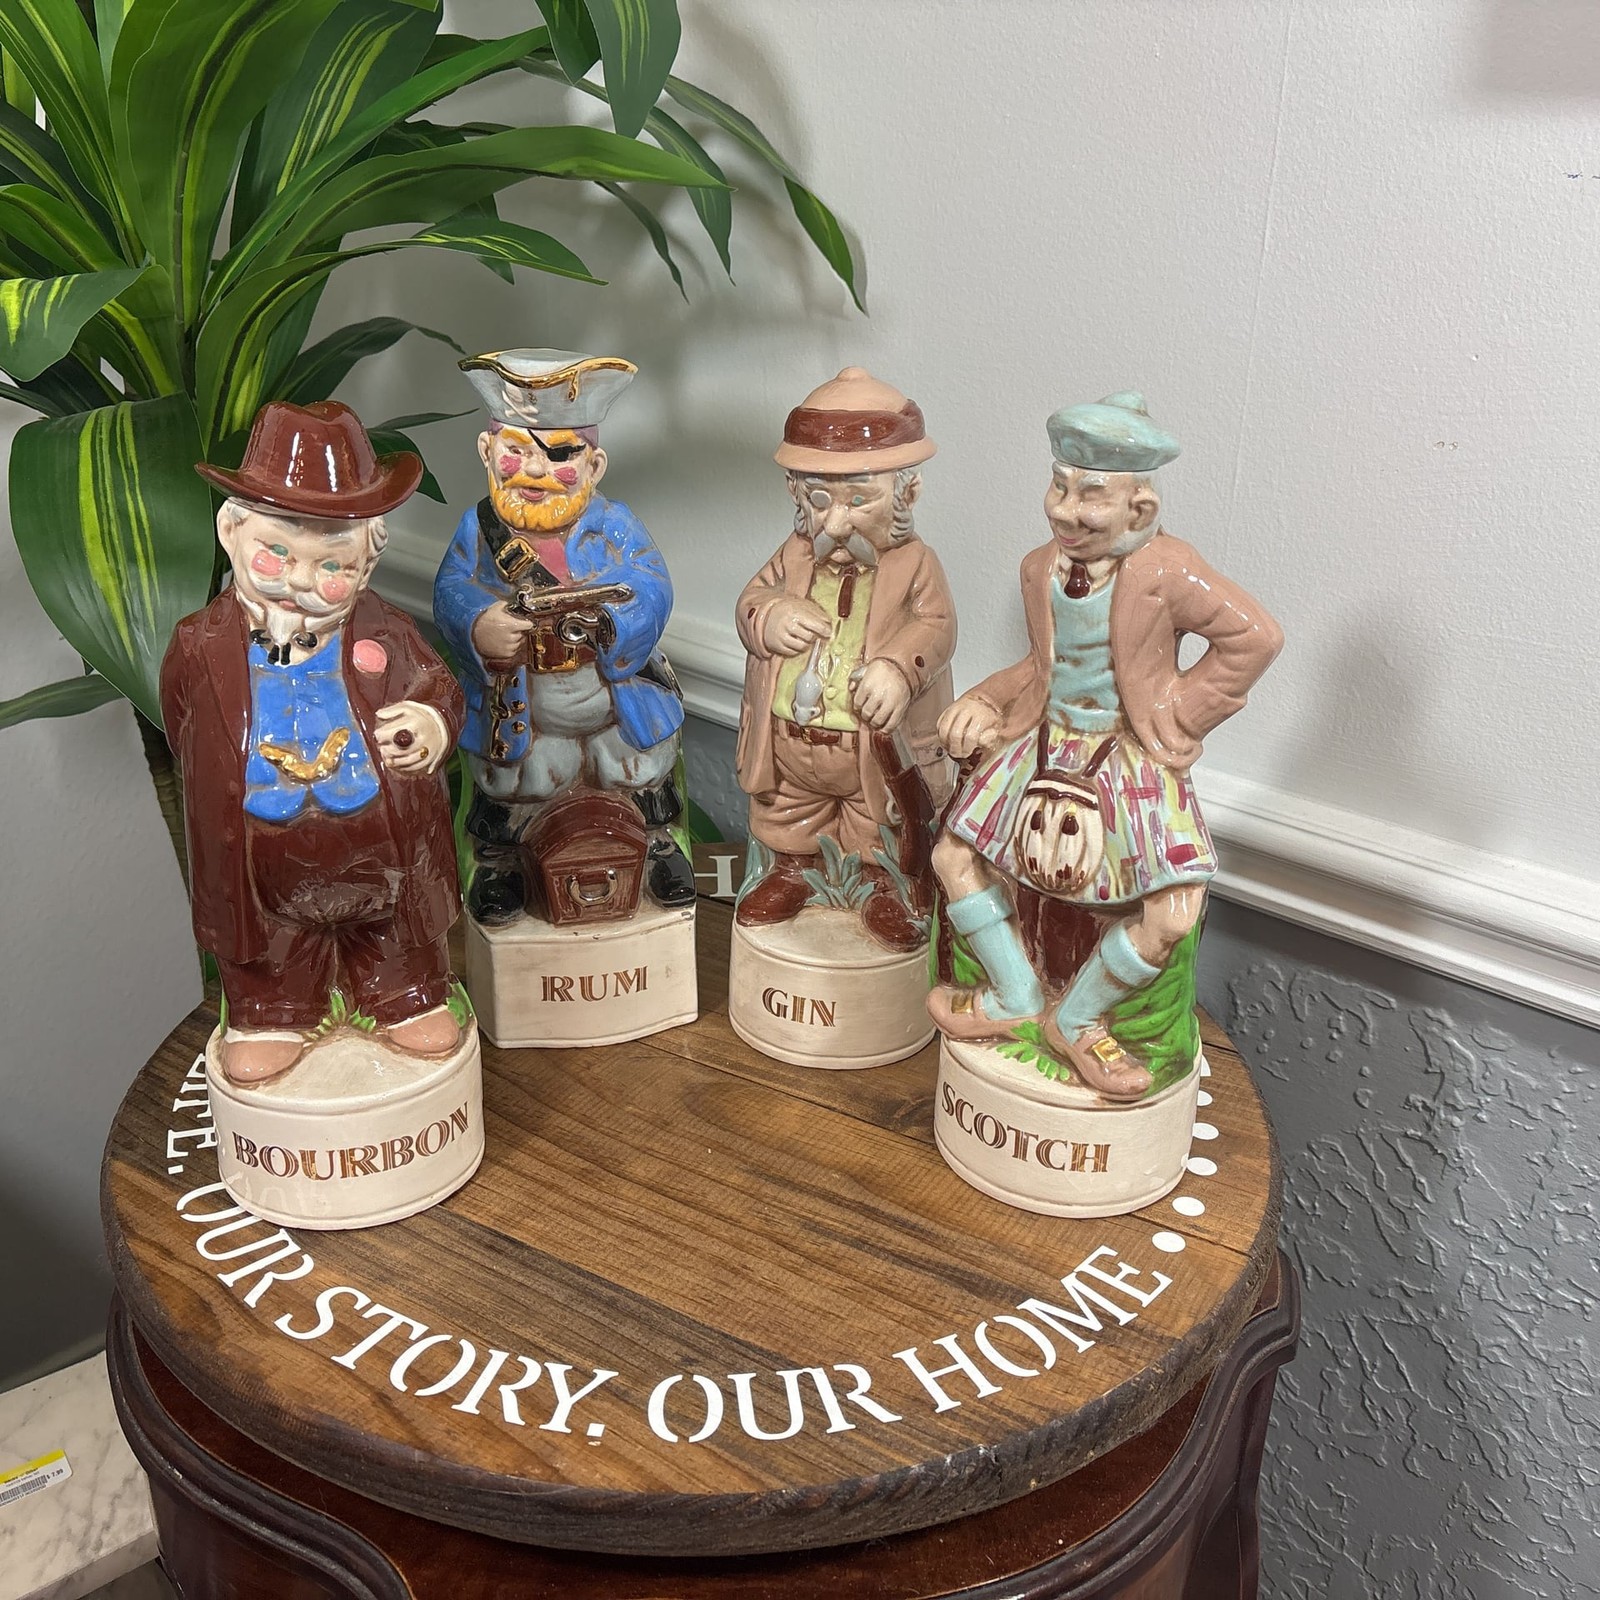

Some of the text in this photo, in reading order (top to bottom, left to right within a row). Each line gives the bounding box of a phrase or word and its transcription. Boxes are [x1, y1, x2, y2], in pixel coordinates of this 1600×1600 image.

[541, 966, 648, 1003] RUM
[762, 987, 837, 1028] GIN
[232, 1102, 469, 1181] BOURBON
[941, 1081, 1111, 1173] SCOTCH
[176, 1182, 315, 1308] OUR
[274, 1286, 619, 1438] STORY.
[647, 1364, 903, 1443] OUR
